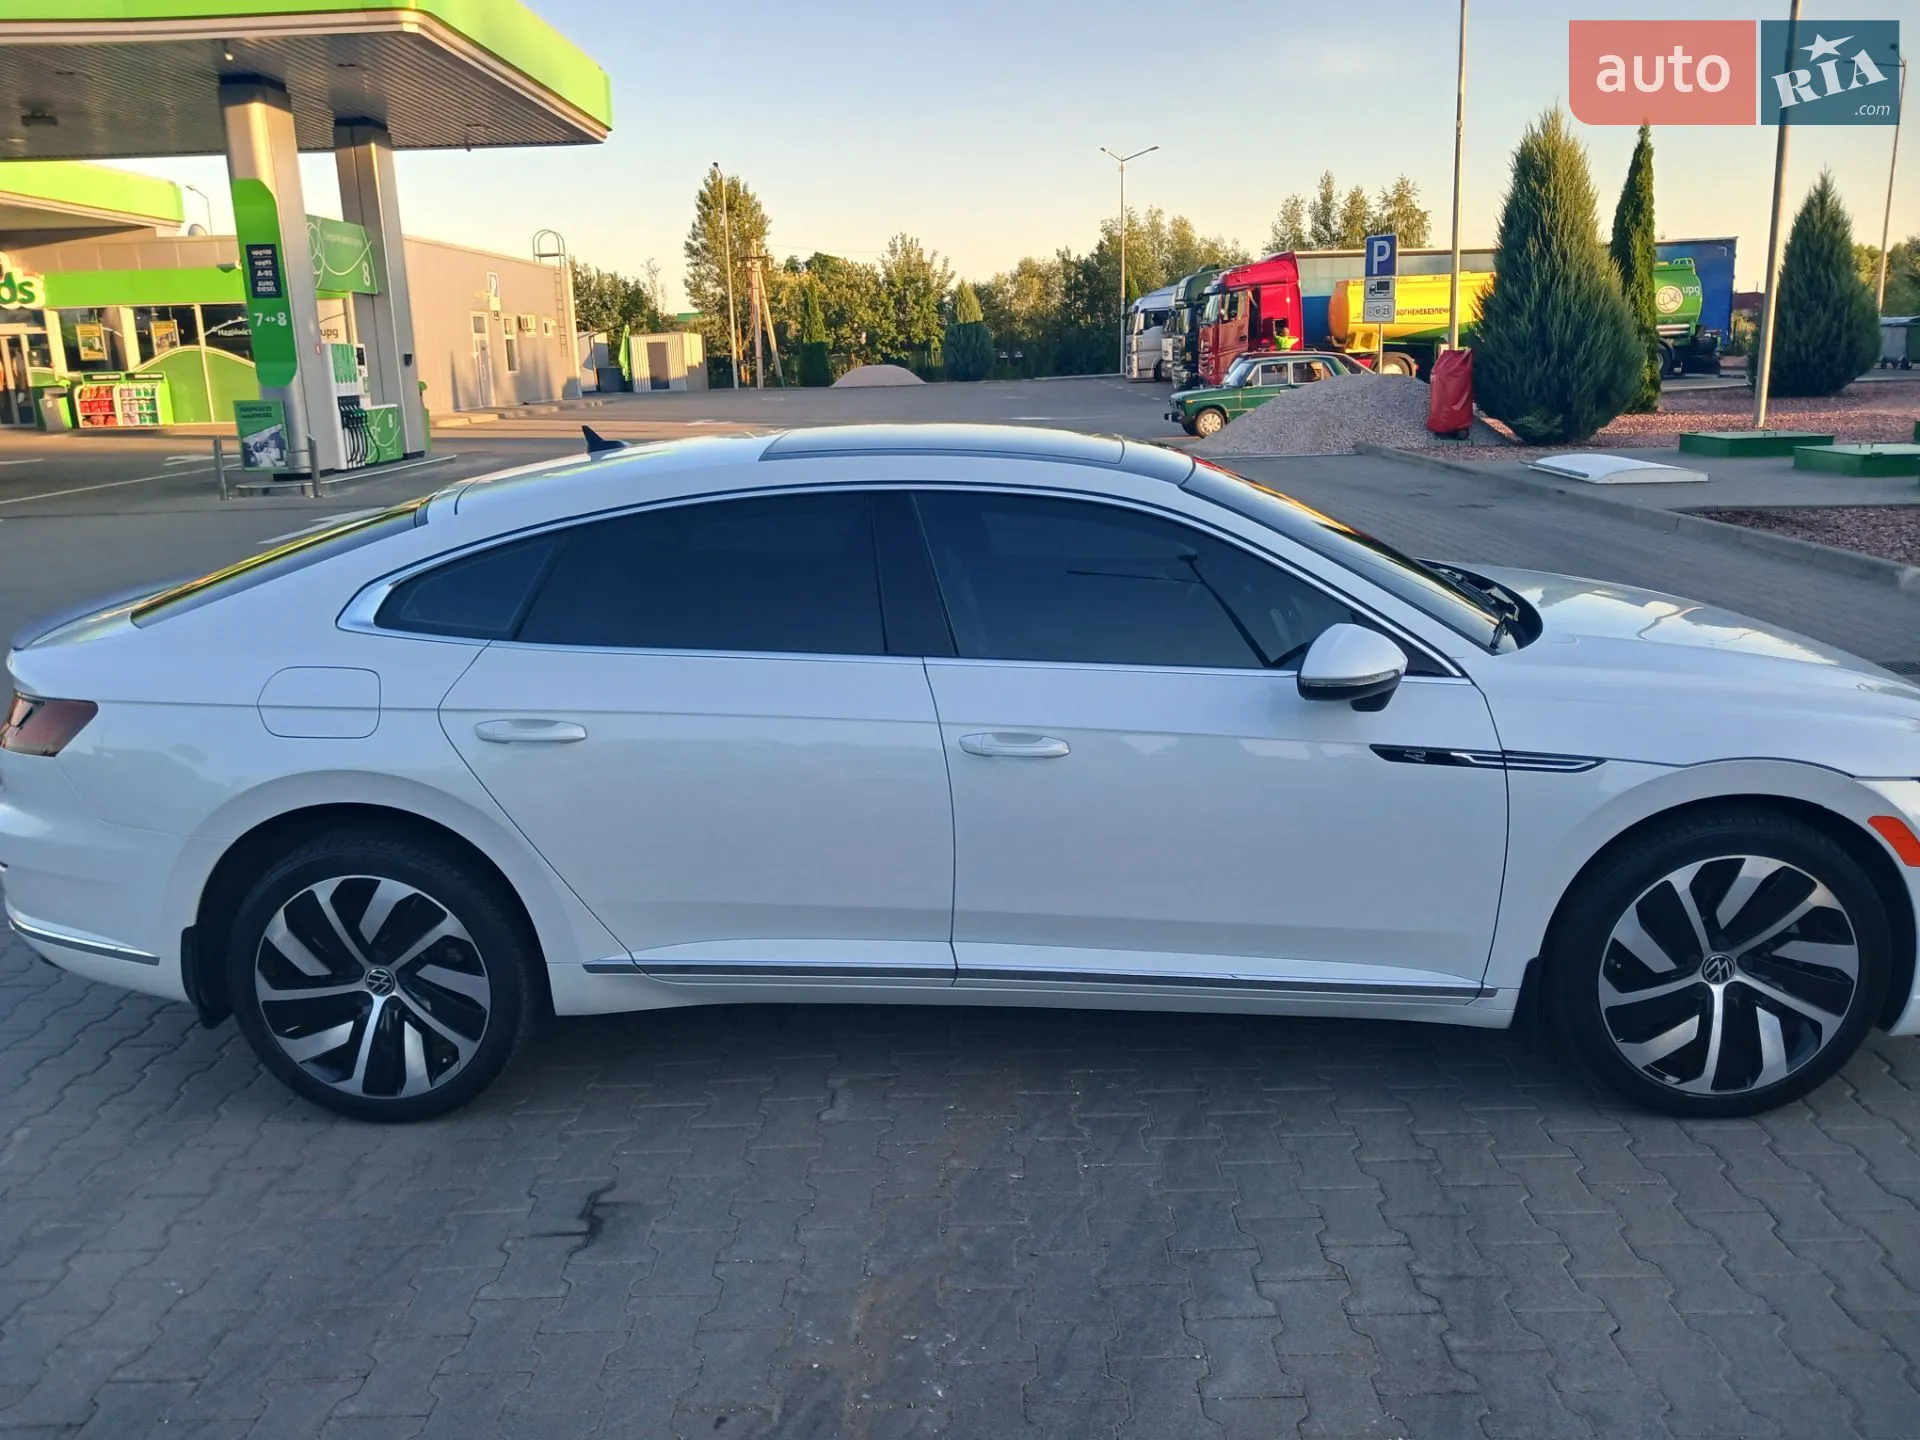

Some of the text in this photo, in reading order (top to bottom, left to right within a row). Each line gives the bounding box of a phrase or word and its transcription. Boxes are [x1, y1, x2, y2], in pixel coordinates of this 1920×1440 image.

[1372, 240, 1391, 275] P
[362, 260, 371, 287] 8
[1681, 285, 1701, 297] upg
[254, 312, 288, 327] 7 8
